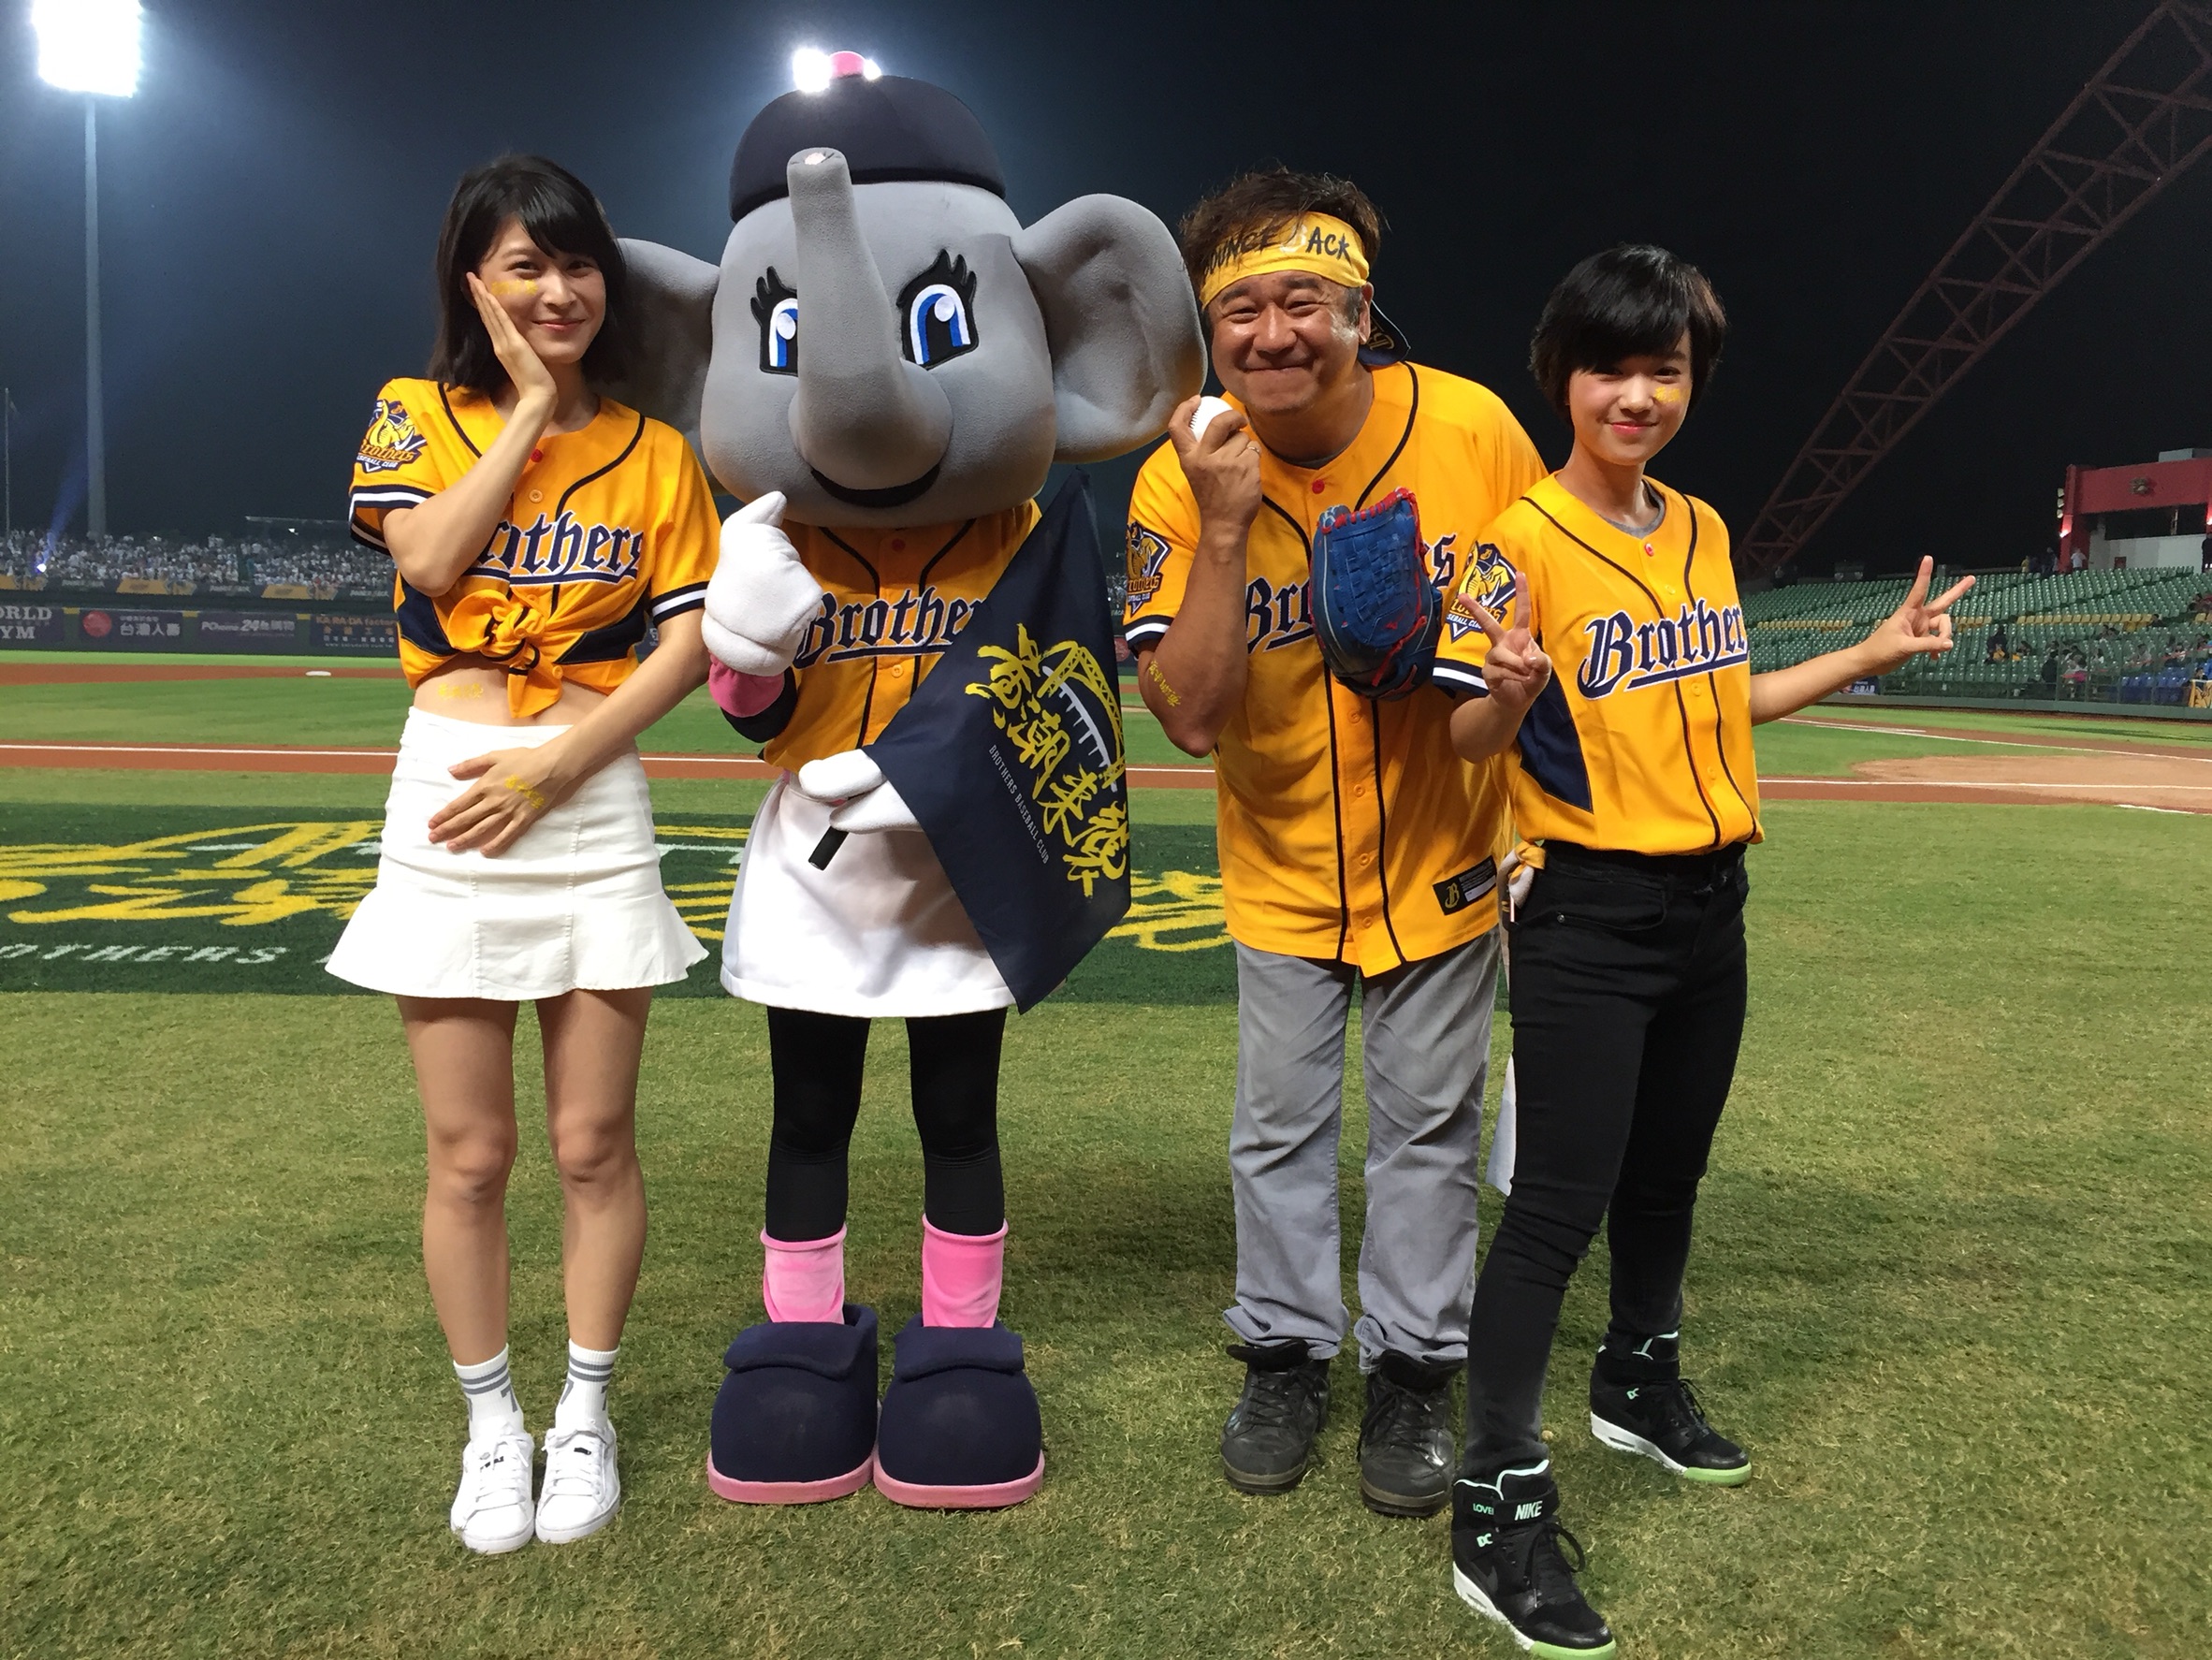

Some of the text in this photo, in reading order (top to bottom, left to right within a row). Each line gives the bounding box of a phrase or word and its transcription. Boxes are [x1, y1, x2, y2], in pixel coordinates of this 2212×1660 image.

[989, 745, 1050, 864] BROTHERS BASEBALL CLUB
[1515, 1500, 1543, 1522] NIKE
